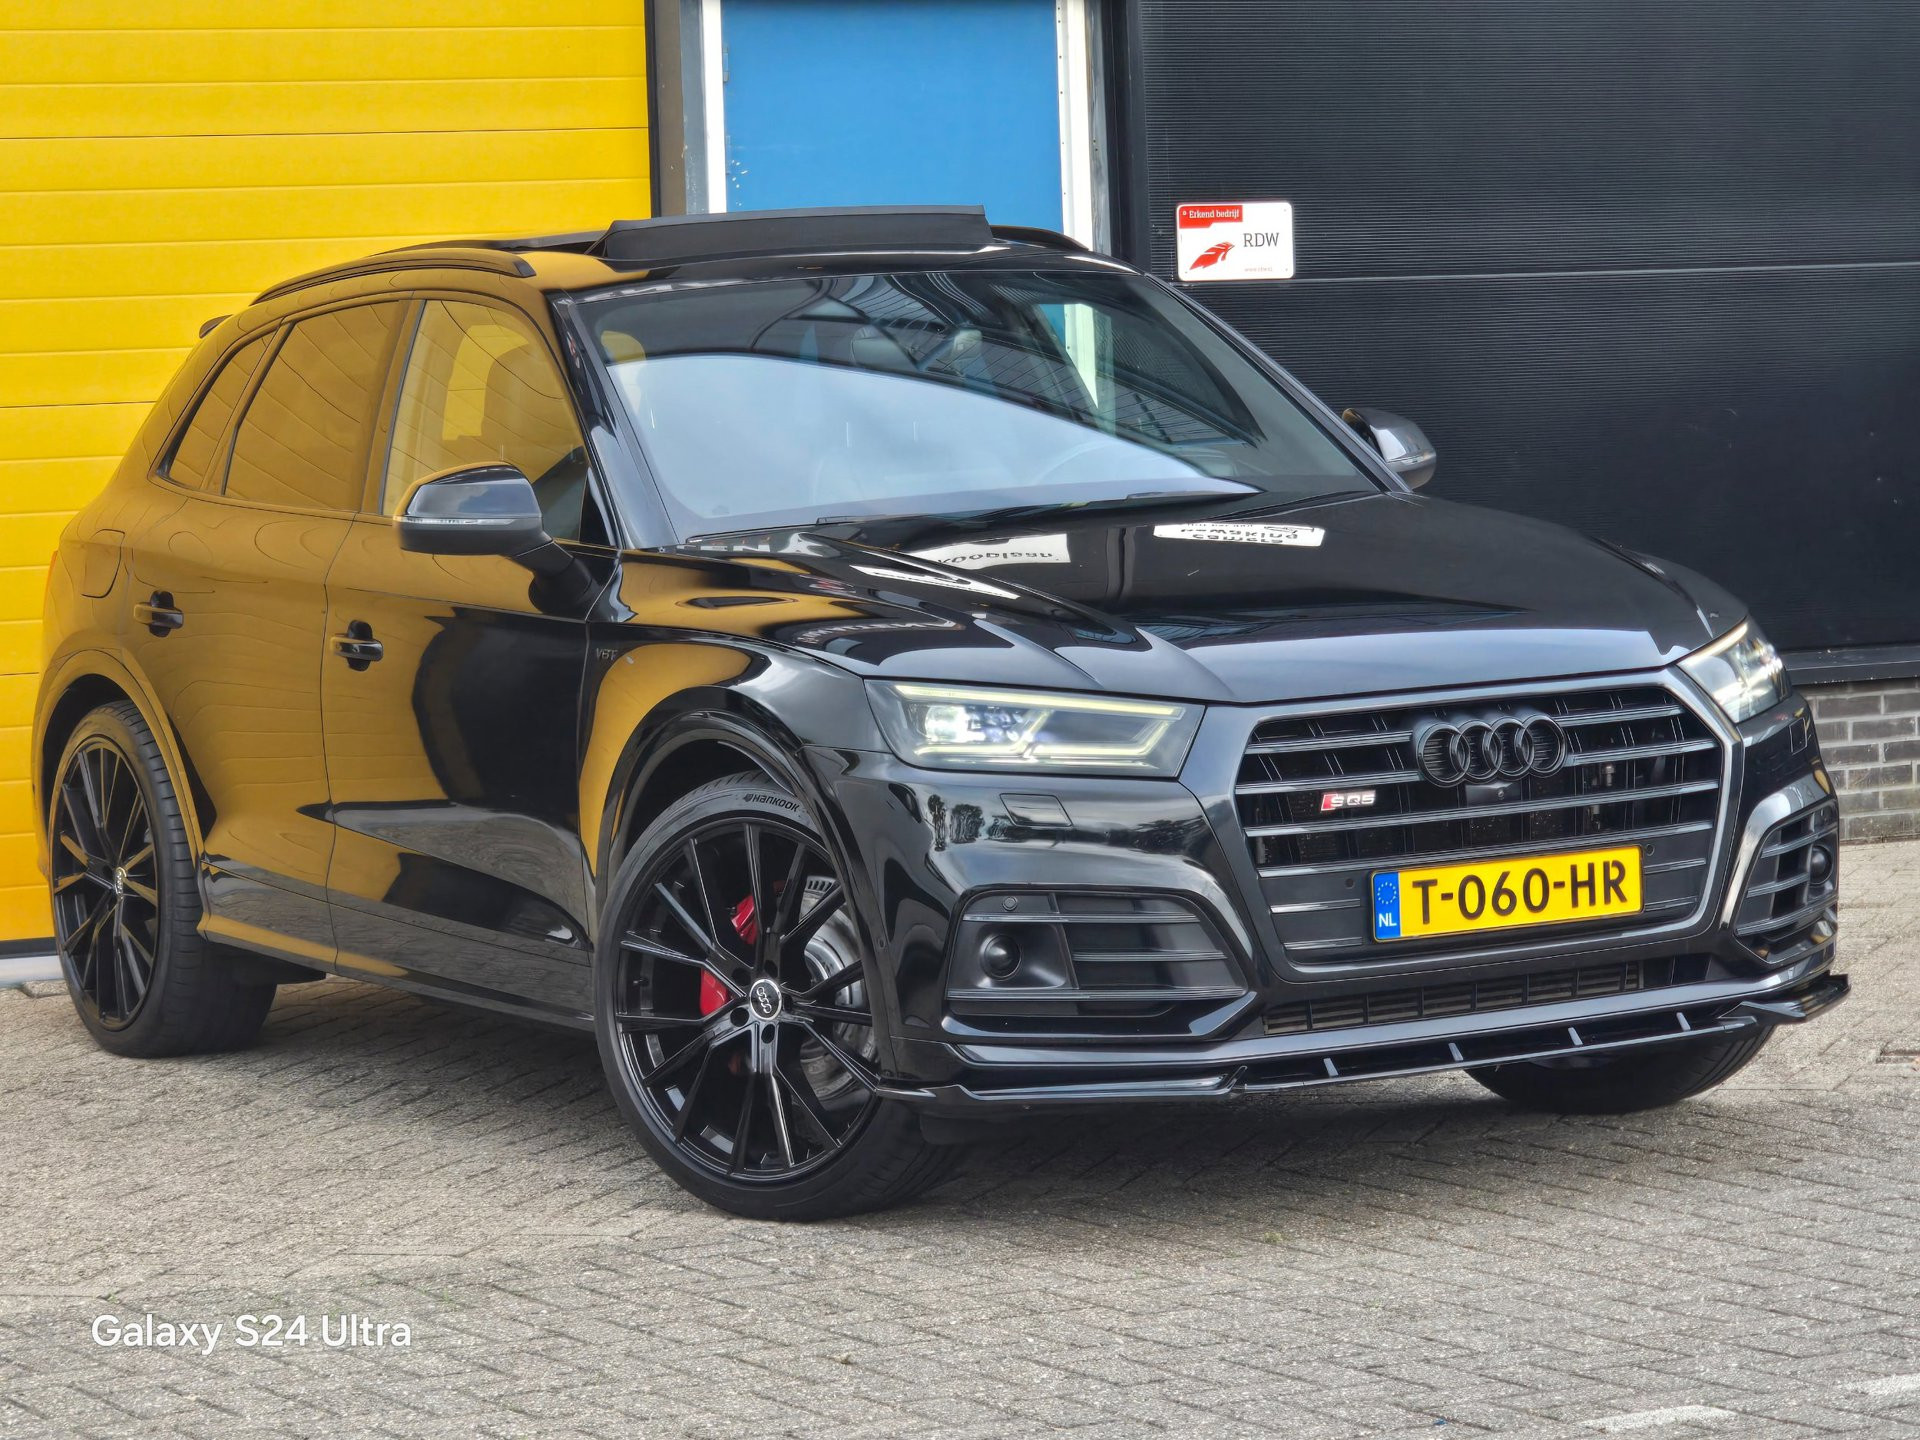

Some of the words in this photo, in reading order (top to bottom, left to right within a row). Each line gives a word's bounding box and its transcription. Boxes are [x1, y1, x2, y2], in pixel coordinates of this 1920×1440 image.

[1215, 209, 1240, 219] bedrijf
[1243, 232, 1280, 247] RDW
[1330, 792, 1375, 807] SQ5
[1411, 859, 1628, 925] T-060-HR
[1377, 912, 1397, 929] NL
